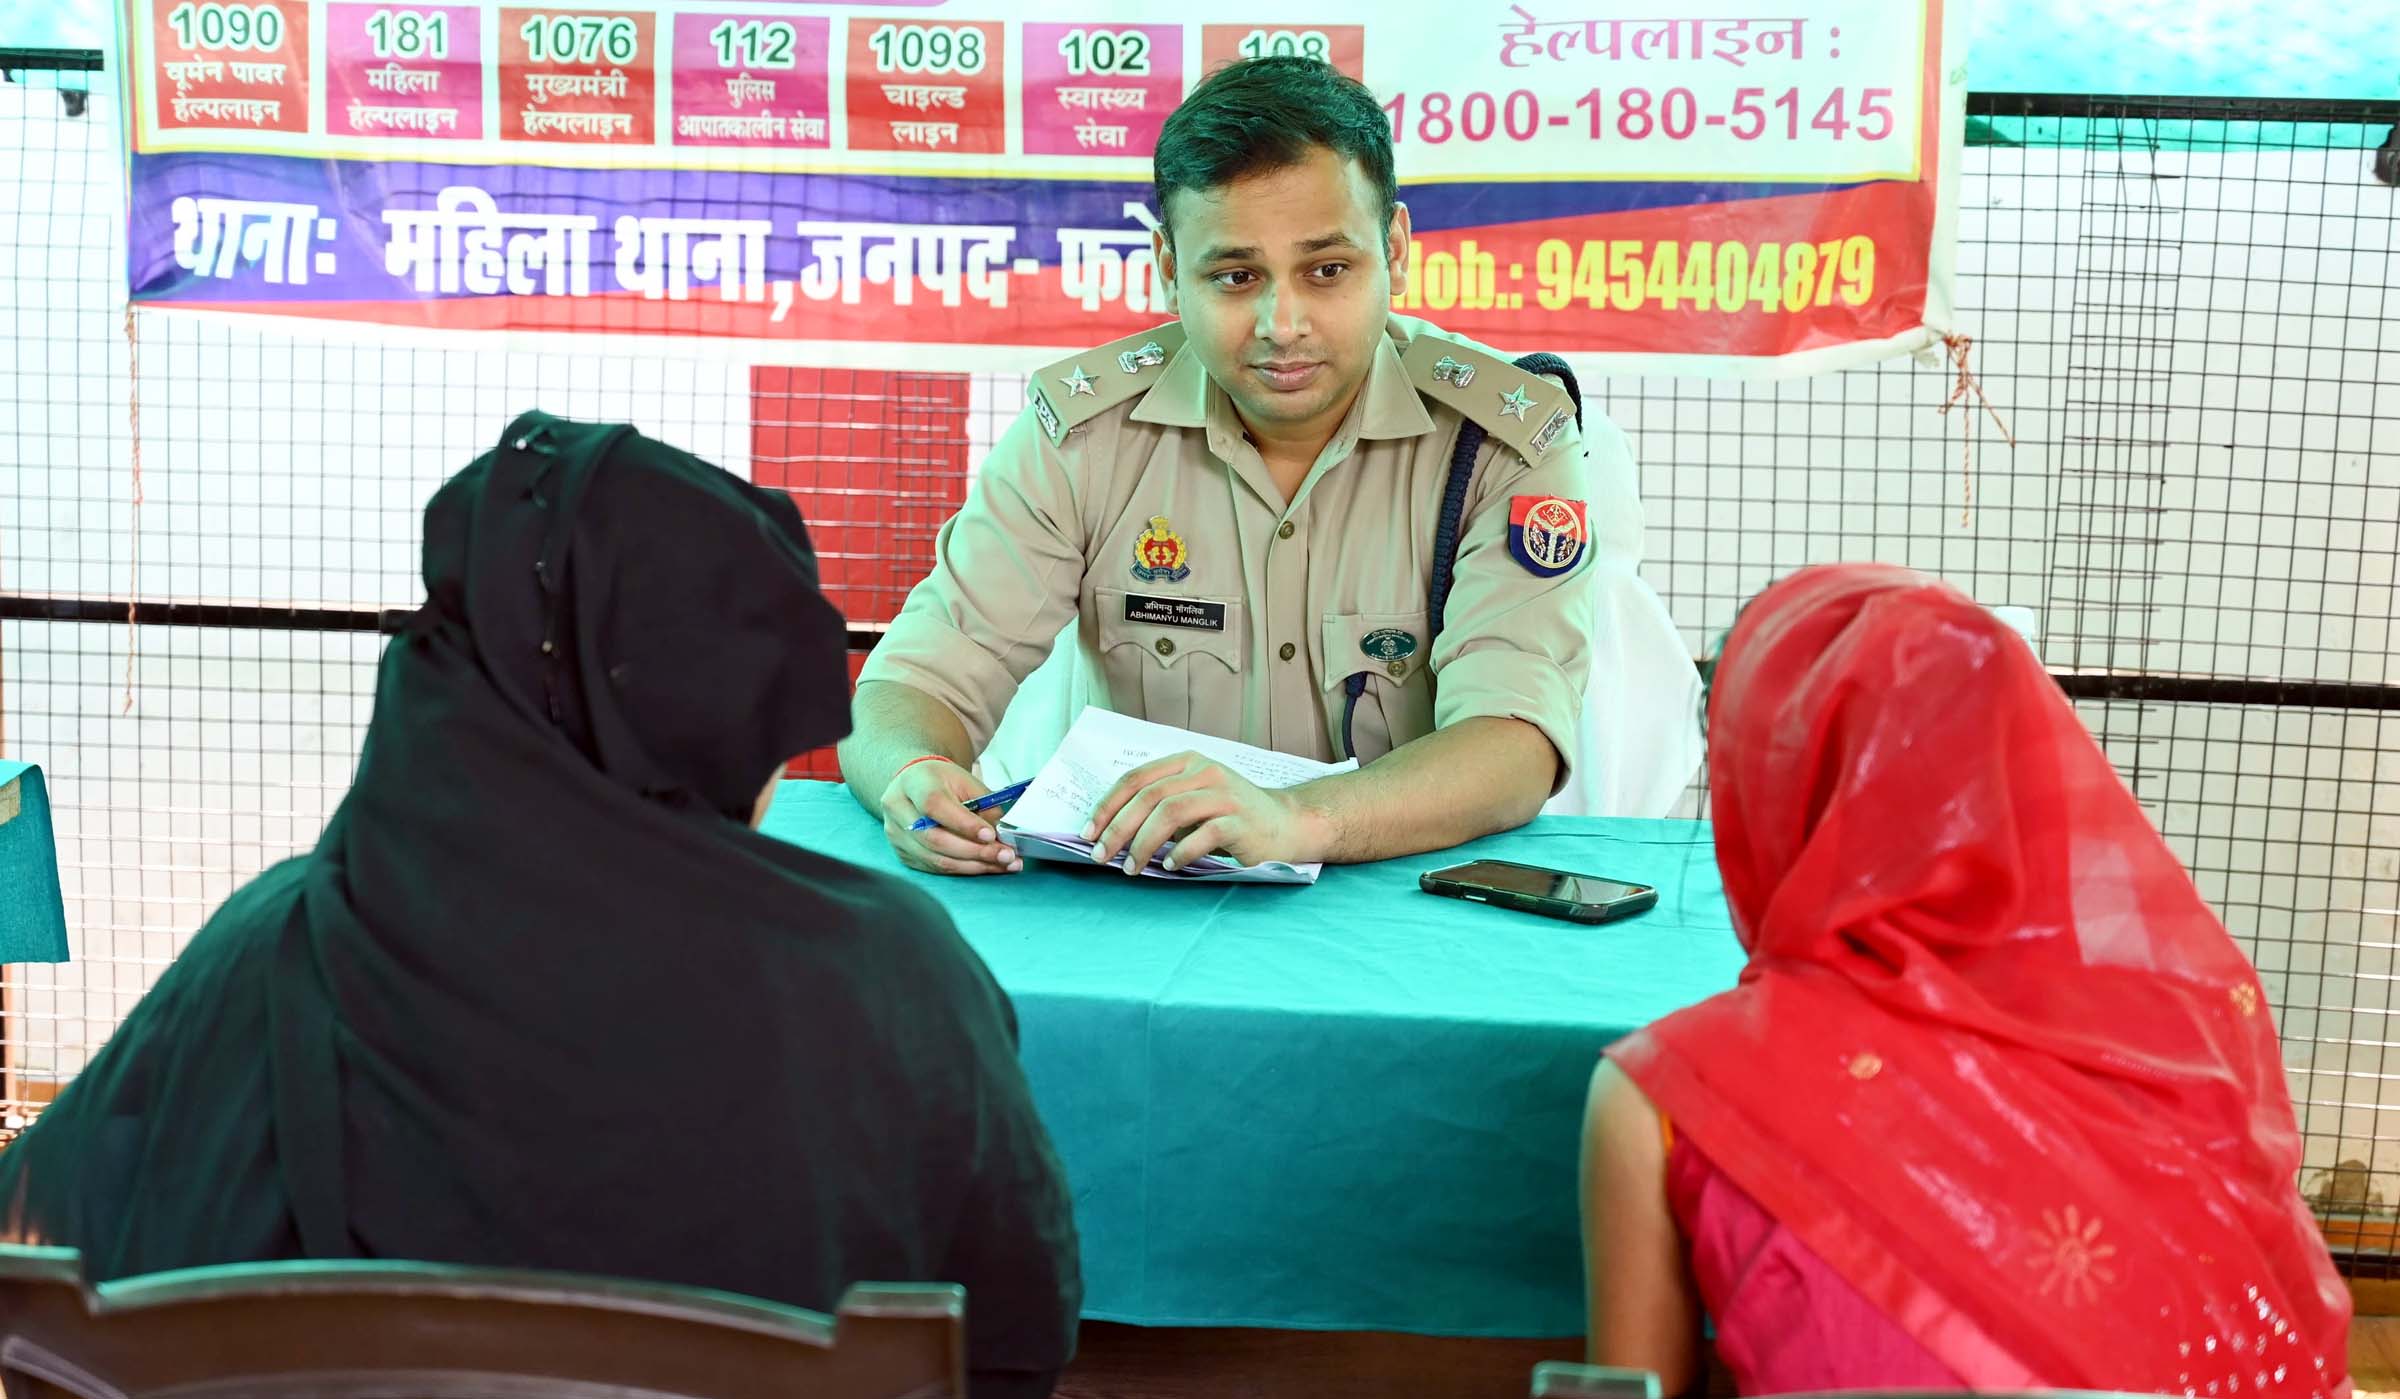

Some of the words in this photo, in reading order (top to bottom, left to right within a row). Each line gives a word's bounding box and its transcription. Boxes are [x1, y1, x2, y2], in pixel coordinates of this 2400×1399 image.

[171, 6, 281, 49] 1090
[368, 13, 448, 55] 181
[523, 18, 633, 60] 1076
[713, 23, 792, 65] 112
[1499, 4, 1809, 68] हेल्पलाइन
[872, 28, 982, 71] 1098
[1061, 33, 1147, 72] 102
[1244, 33, 1327, 61] 108
[164, 54, 222, 91] वूमेन
[230, 61, 286, 85] पावर
[365, 62, 441, 95] महिला
[524, 69, 629, 103] मुख्यमंत्री
[726, 72, 776, 109] पुलिस
[170, 92, 281, 126] हेल्पलाइन
[881, 84, 968, 111] चाइल्ड
[1056, 86, 1148, 110] स्वास्थ्य
[1384, 86, 1894, 145] 1800-180-5145
[347, 98, 459, 134] हेल्पलाइन
[521, 104, 633, 140] हेल्पलाइन
[677, 110, 786, 139] आपातकालीन
[790, 111, 826, 140] सेवा
[1074, 118, 1129, 148] सेवा
[889, 121, 960, 149] लाइन
[382, 186, 597, 297] महिला
[1536, 235, 1876, 313] 9454404879
[1129, 610, 1179, 623] ABHIMANYU
[1180, 615, 1218, 627] MANGLIK
